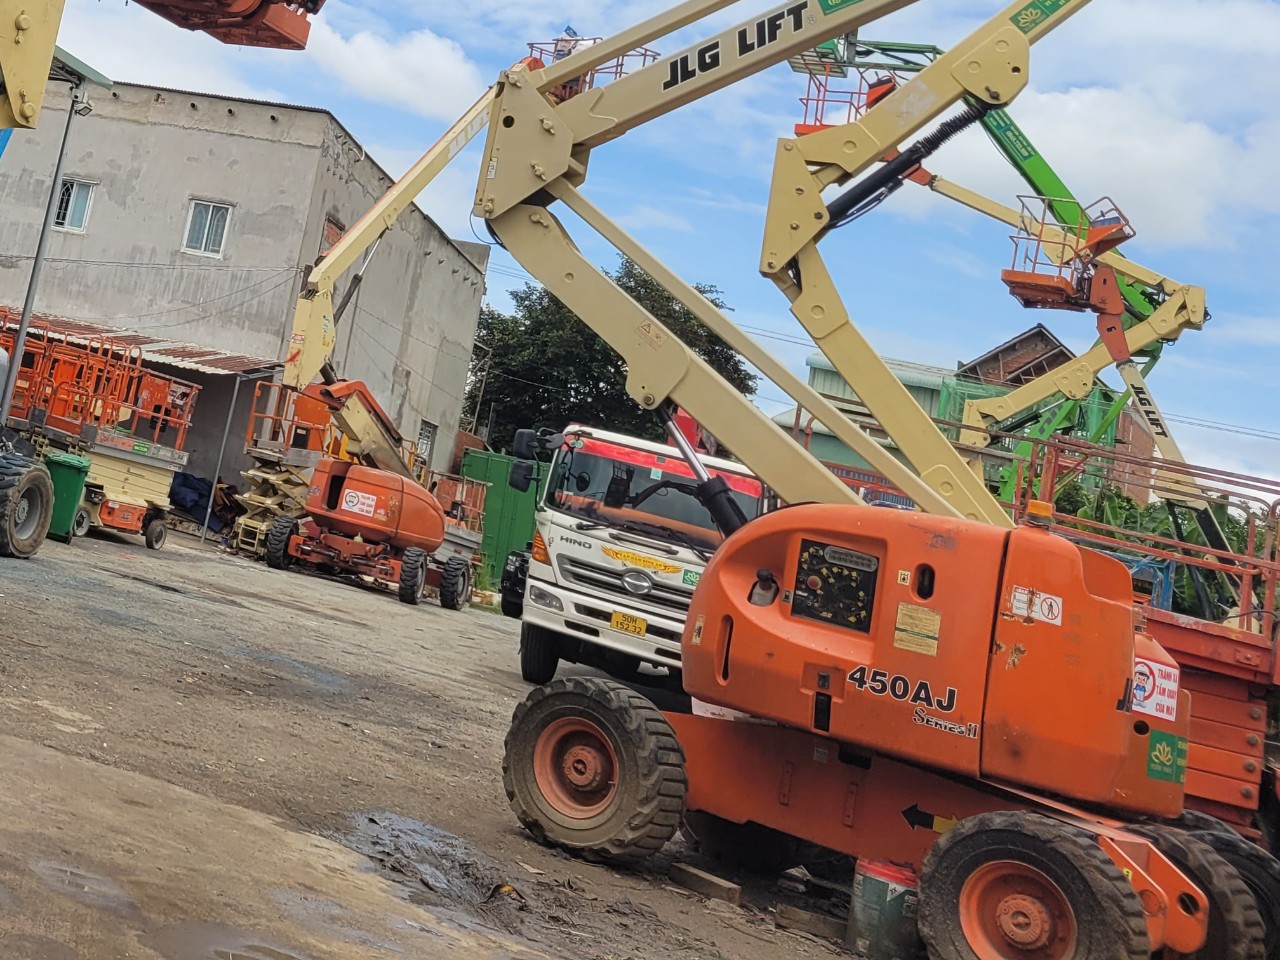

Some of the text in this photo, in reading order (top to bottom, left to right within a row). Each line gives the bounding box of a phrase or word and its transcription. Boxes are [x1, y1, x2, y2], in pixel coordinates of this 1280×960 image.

[662, 0, 808, 91] JLG LIFT
[1130, 384, 1169, 439] JLG LIFT
[560, 535, 592, 550] HINO
[621, 614, 638, 625] 50H
[847, 665, 957, 713] 450AJ
